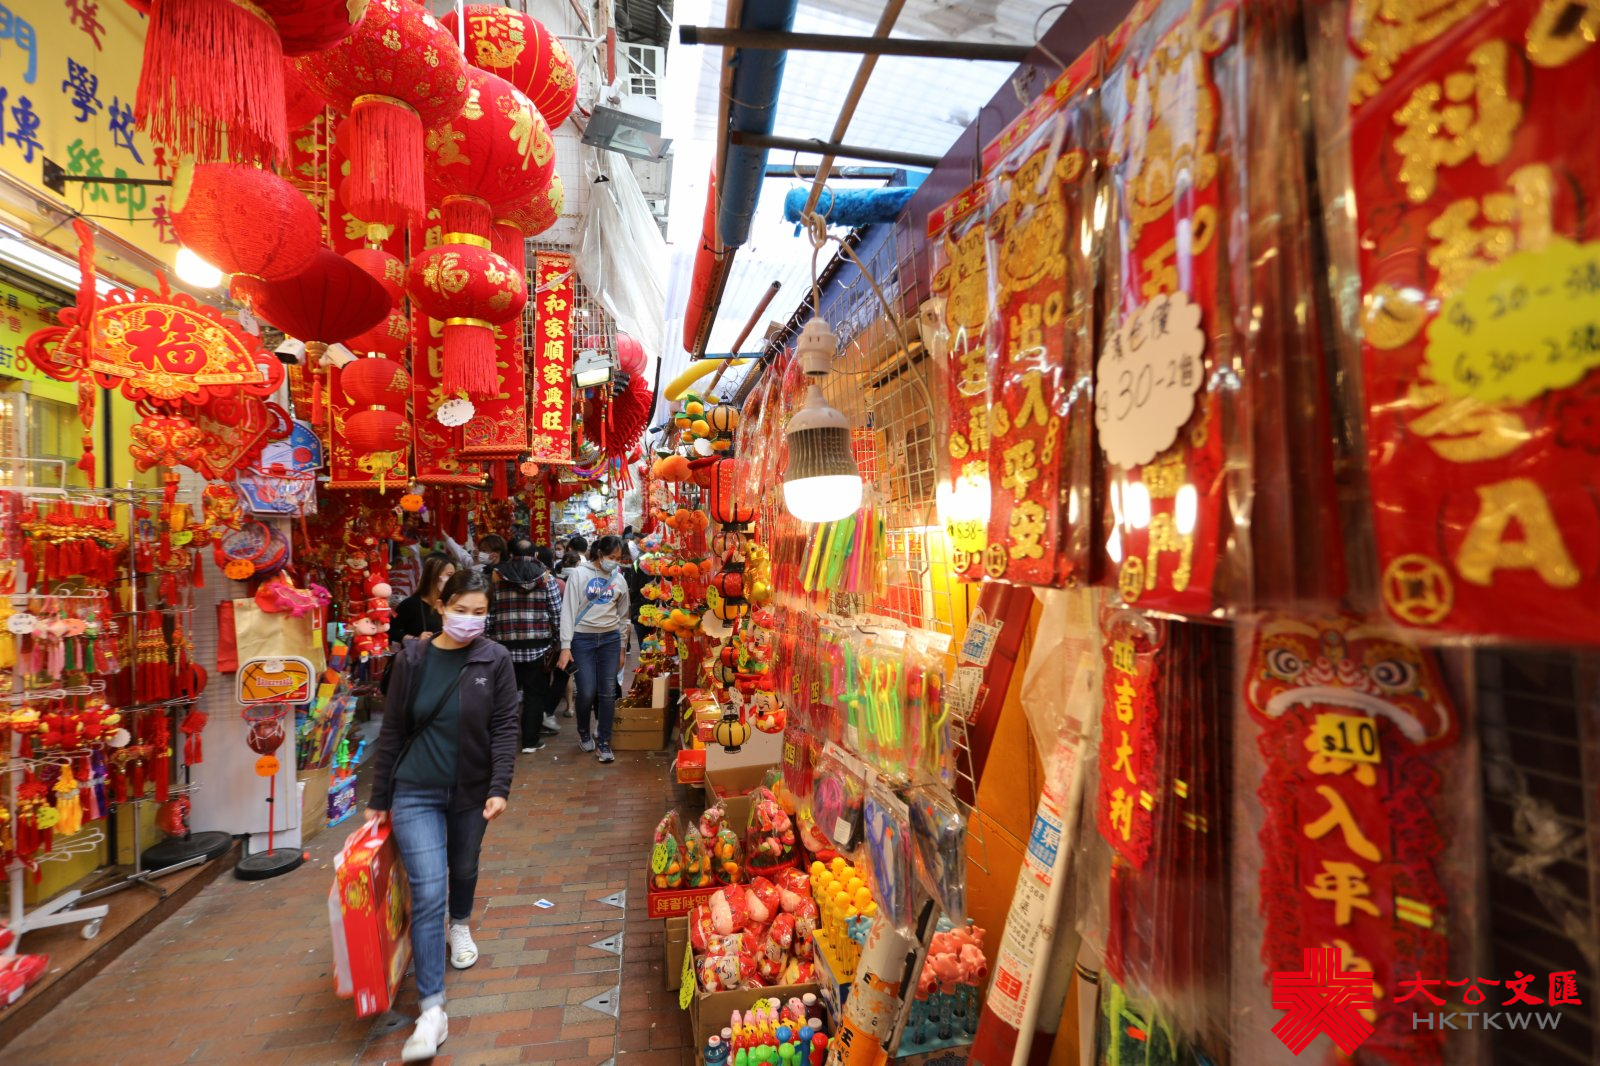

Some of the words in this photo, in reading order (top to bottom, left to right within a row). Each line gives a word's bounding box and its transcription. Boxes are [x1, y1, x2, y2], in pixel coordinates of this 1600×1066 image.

[423, 252, 470, 299] 福
[124, 309, 208, 374] 福
[541, 270, 568, 431] 家和家順家興旺
[1002, 303, 1049, 560] 出入平安
[1110, 676, 1137, 842] 吉大利
[1322, 721, 1377, 756] $10
